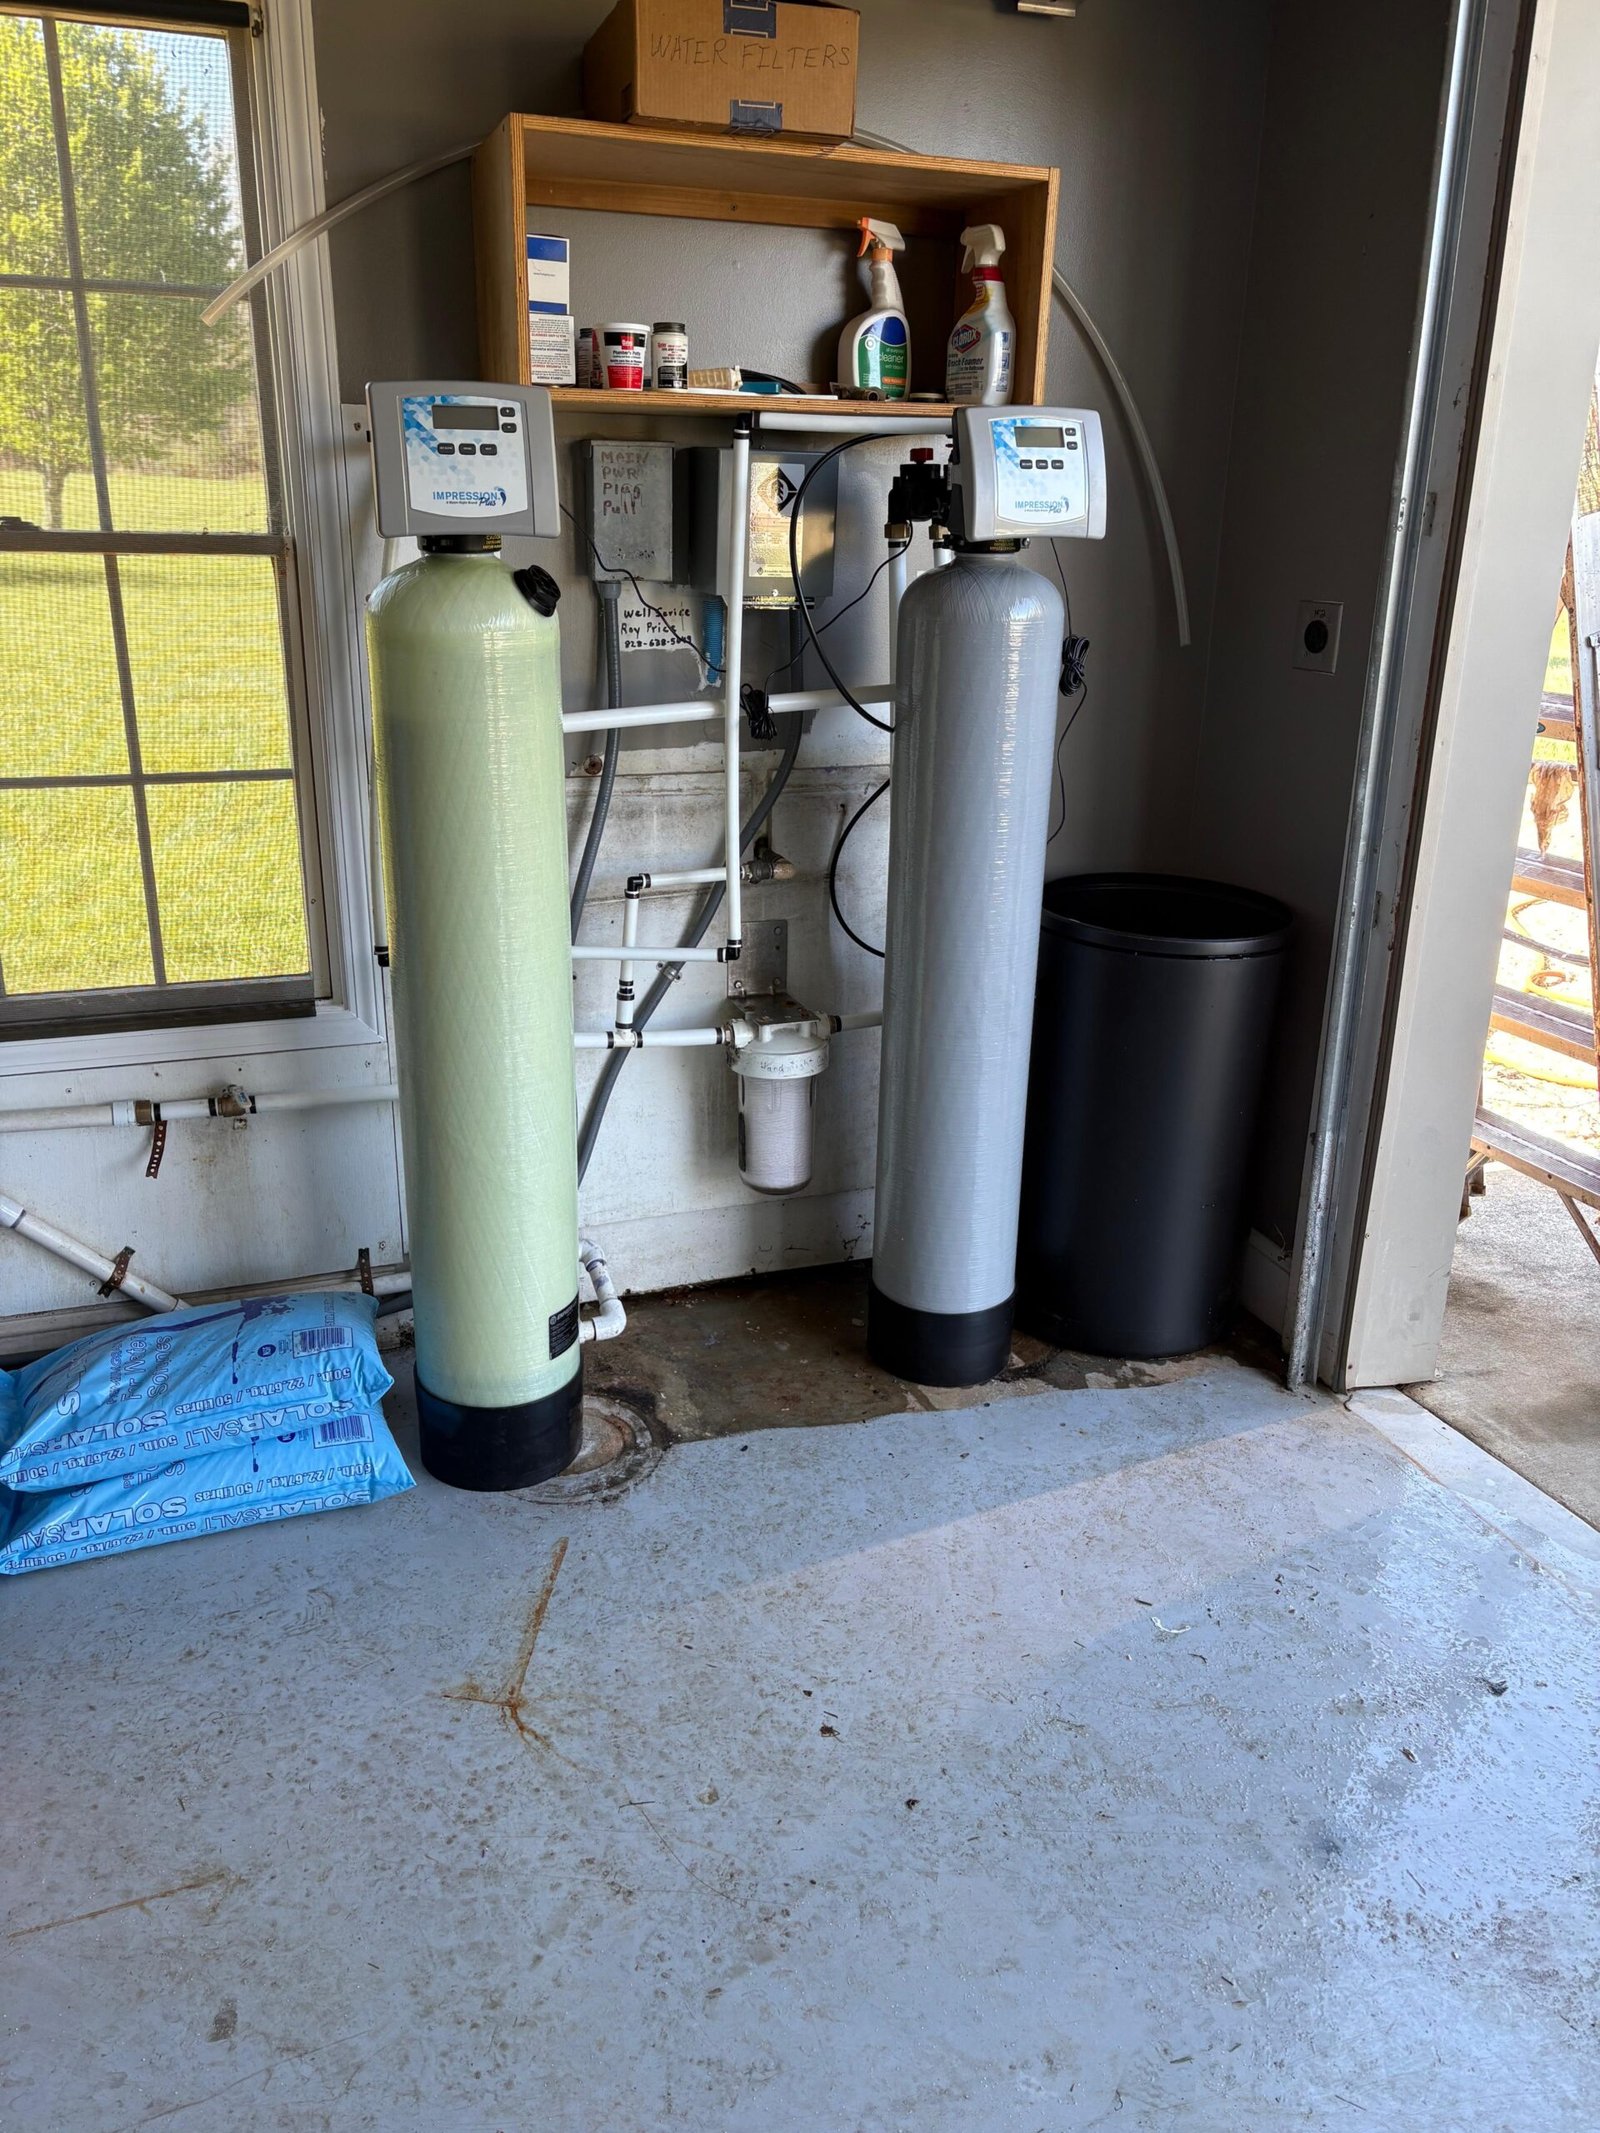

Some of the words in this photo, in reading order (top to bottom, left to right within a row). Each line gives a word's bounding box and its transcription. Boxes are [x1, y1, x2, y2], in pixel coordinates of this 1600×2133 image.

[651, 33, 728, 66] WATER
[741, 42, 851, 70] FILTERS
[601, 451, 649, 463] MAIN
[602, 465, 639, 480] PWR
[432, 491, 498, 501] IMPRESSION
[603, 500, 636, 516] Pull
[1015, 501, 1063, 509] IMPRESSION
[624, 607, 651, 619] Well
[647, 621, 677, 633] Price
[246, 1376, 304, 1397] 22.67kg.
[175, 1396, 217, 1416] Libras
[217, 1393, 232, 1407] 50
[139, 1434, 178, 1450] 50lb.
[62, 1447, 126, 1470] 22.67kg.
[31, 1466, 48, 1479] 50
[266, 1470, 324, 1488] 22.67kg.
[195, 1484, 238, 1502] Libras
[237, 1482, 252, 1495] 50
[49, 1552, 66, 1563] 50
